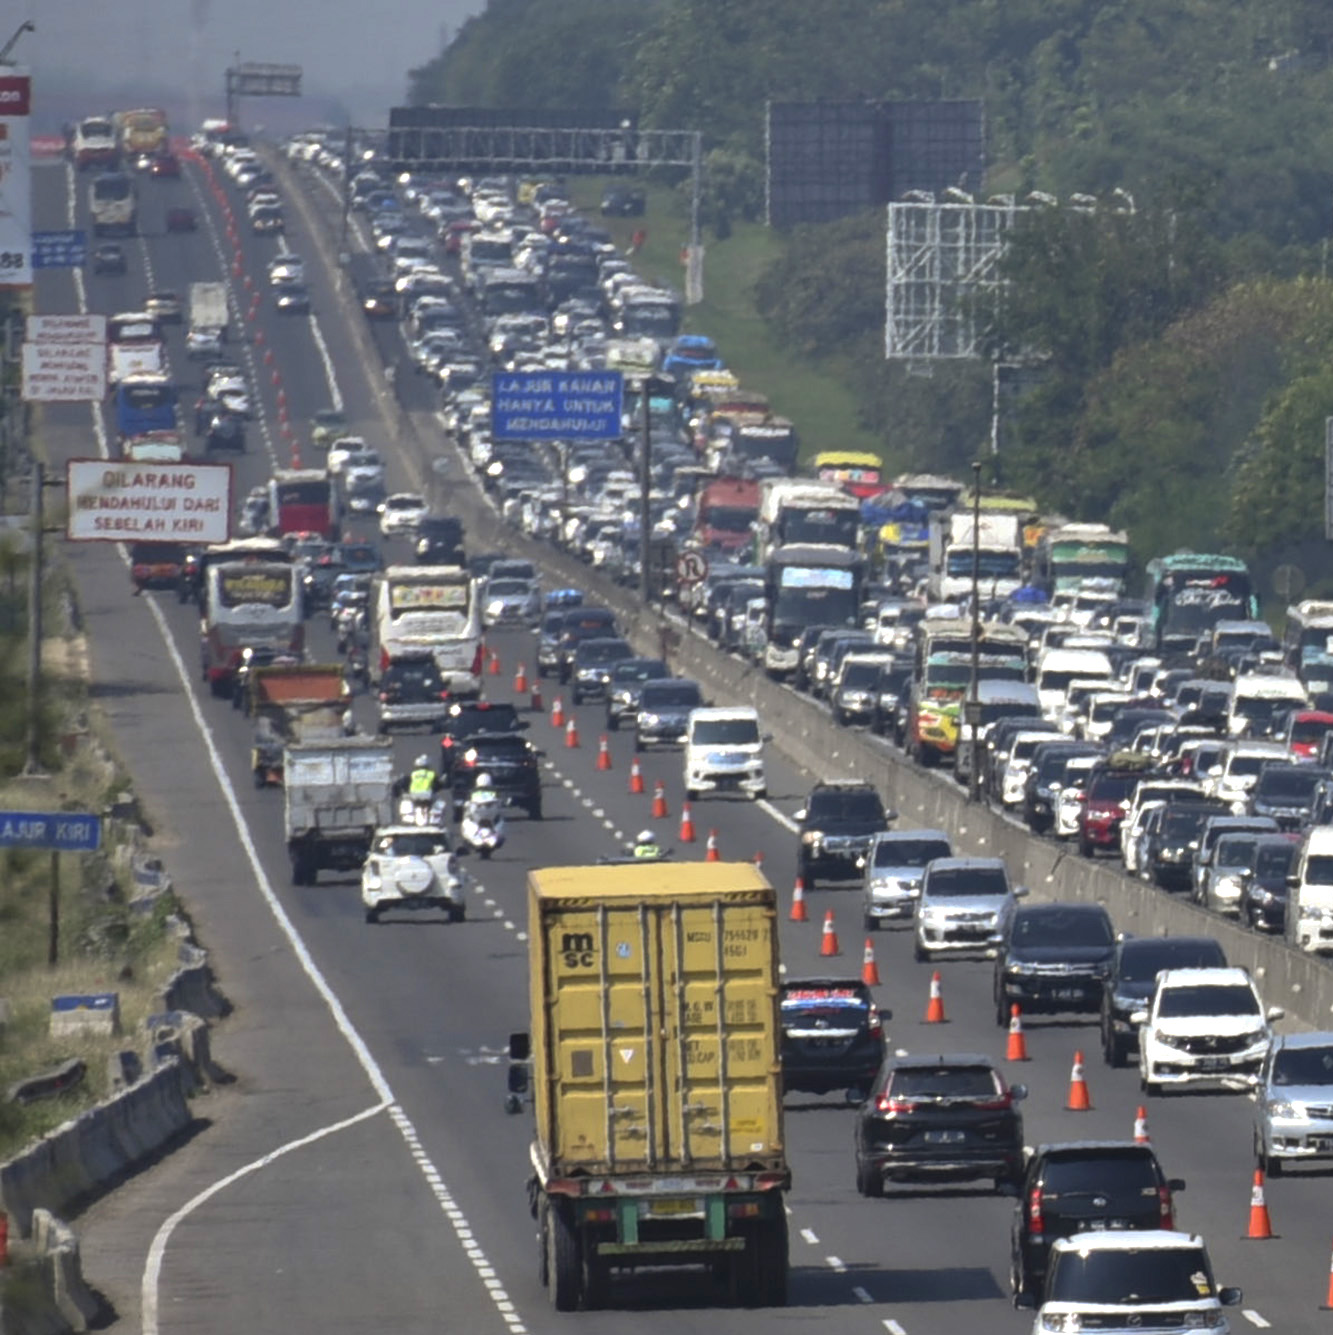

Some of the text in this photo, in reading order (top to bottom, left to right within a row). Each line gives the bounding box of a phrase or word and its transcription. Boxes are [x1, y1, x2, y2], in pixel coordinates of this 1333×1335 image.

[102, 470, 196, 489] DILARANG
[76, 494, 221, 512] MENDAHULUI DARI
[93, 516, 205, 533] SEBELAH KIRI
[55, 822, 91, 841] KIRI
